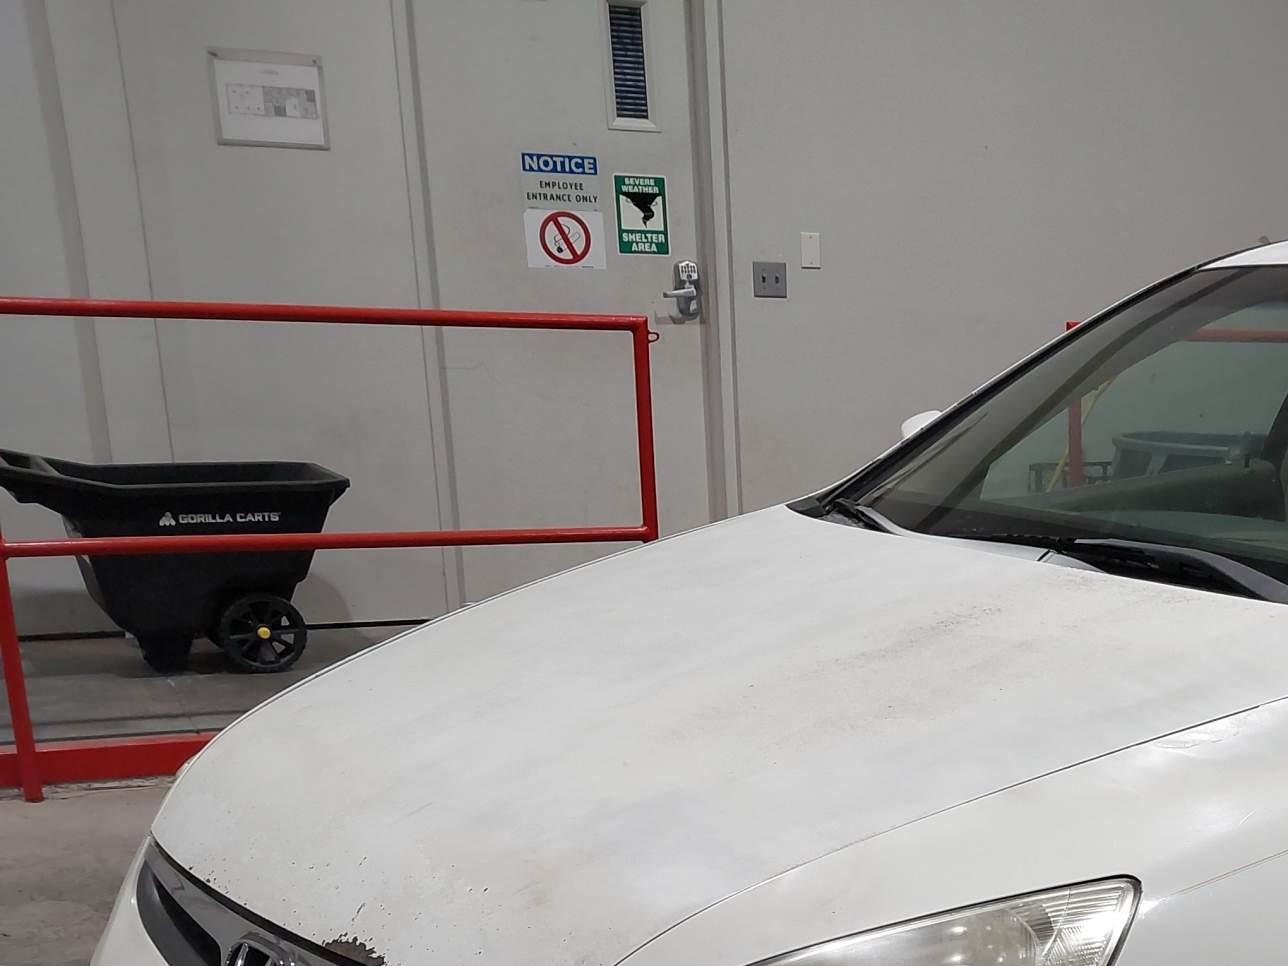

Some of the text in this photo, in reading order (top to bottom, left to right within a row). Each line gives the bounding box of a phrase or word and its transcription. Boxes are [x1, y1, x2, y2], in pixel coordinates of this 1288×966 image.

[523, 154, 596, 174] NOTICE
[539, 180, 585, 191] EMPLOYEE
[624, 178, 656, 186] SEVERE
[621, 185, 660, 194] WEATHER
[526, 192, 599, 204] ENTRANCE ONLY
[622, 232, 666, 243] SHELTER
[631, 242, 658, 253] AREA
[178, 512, 280, 524] GORILLA CARTS
